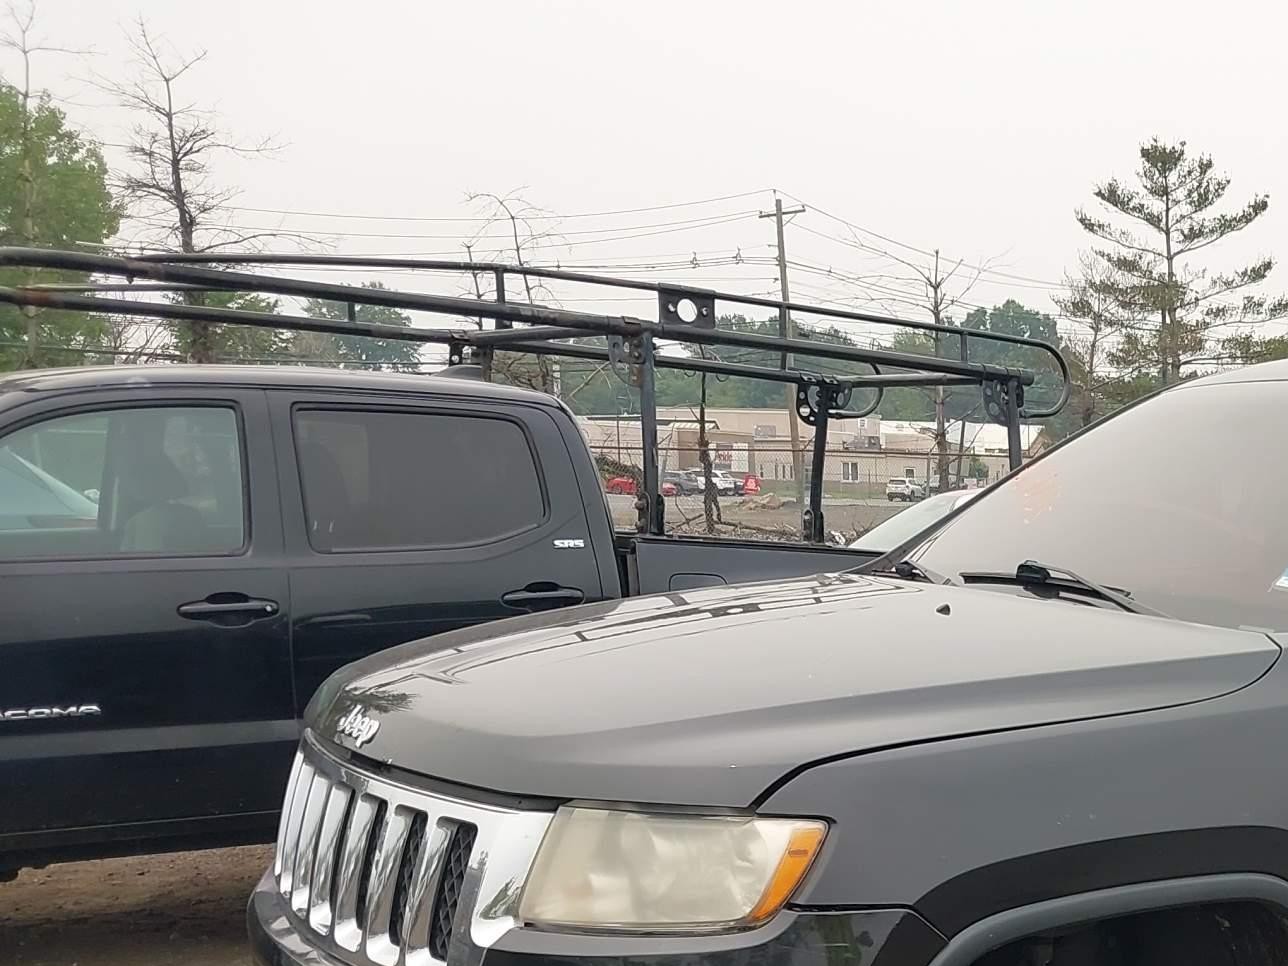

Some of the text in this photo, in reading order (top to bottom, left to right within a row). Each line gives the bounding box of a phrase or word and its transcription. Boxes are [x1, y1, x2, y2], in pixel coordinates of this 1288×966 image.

[553, 539, 585, 549] SR5
[0, 705, 102, 720] COMA
[336, 704, 380, 748] Jeep
